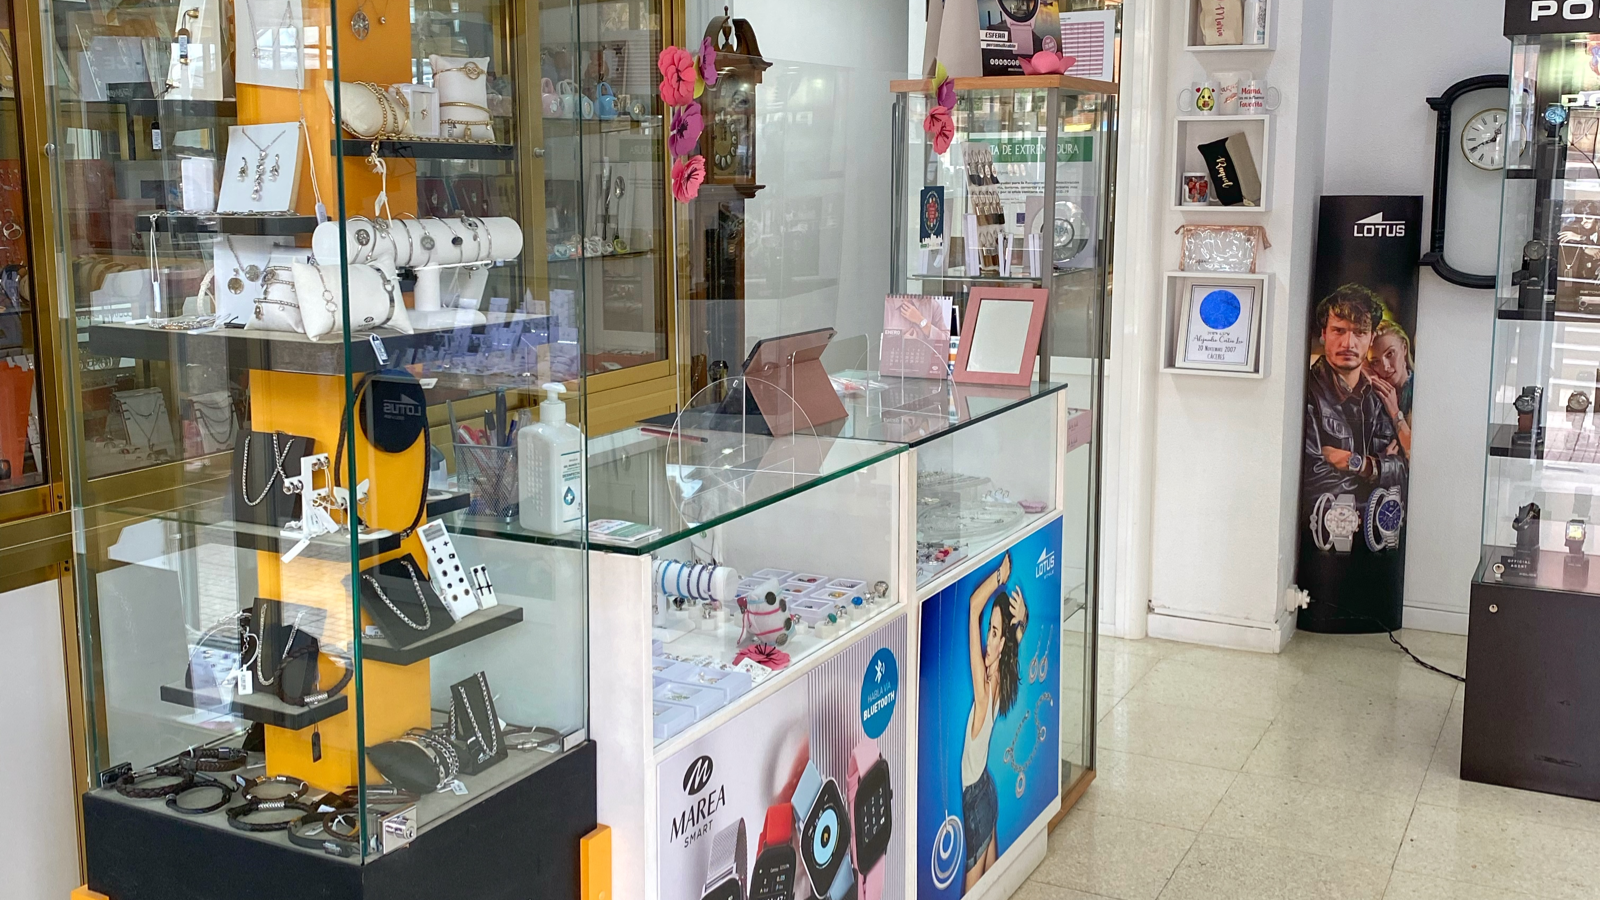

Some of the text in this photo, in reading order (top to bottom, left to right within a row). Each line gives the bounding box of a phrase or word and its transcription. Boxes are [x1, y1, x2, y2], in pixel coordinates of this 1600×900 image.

[1531, 0, 1600, 21] PO
[1002, 145, 1012, 155] DE
[1015, 144, 1080, 155] EXTREMDURA
[1353, 224, 1406, 237] LOTUS
[1035, 554, 1055, 579] LOTUS
[863, 690, 895, 722] BLUETOOTH
[670, 784, 726, 844] MAREA
[683, 819, 713, 849] SMART
